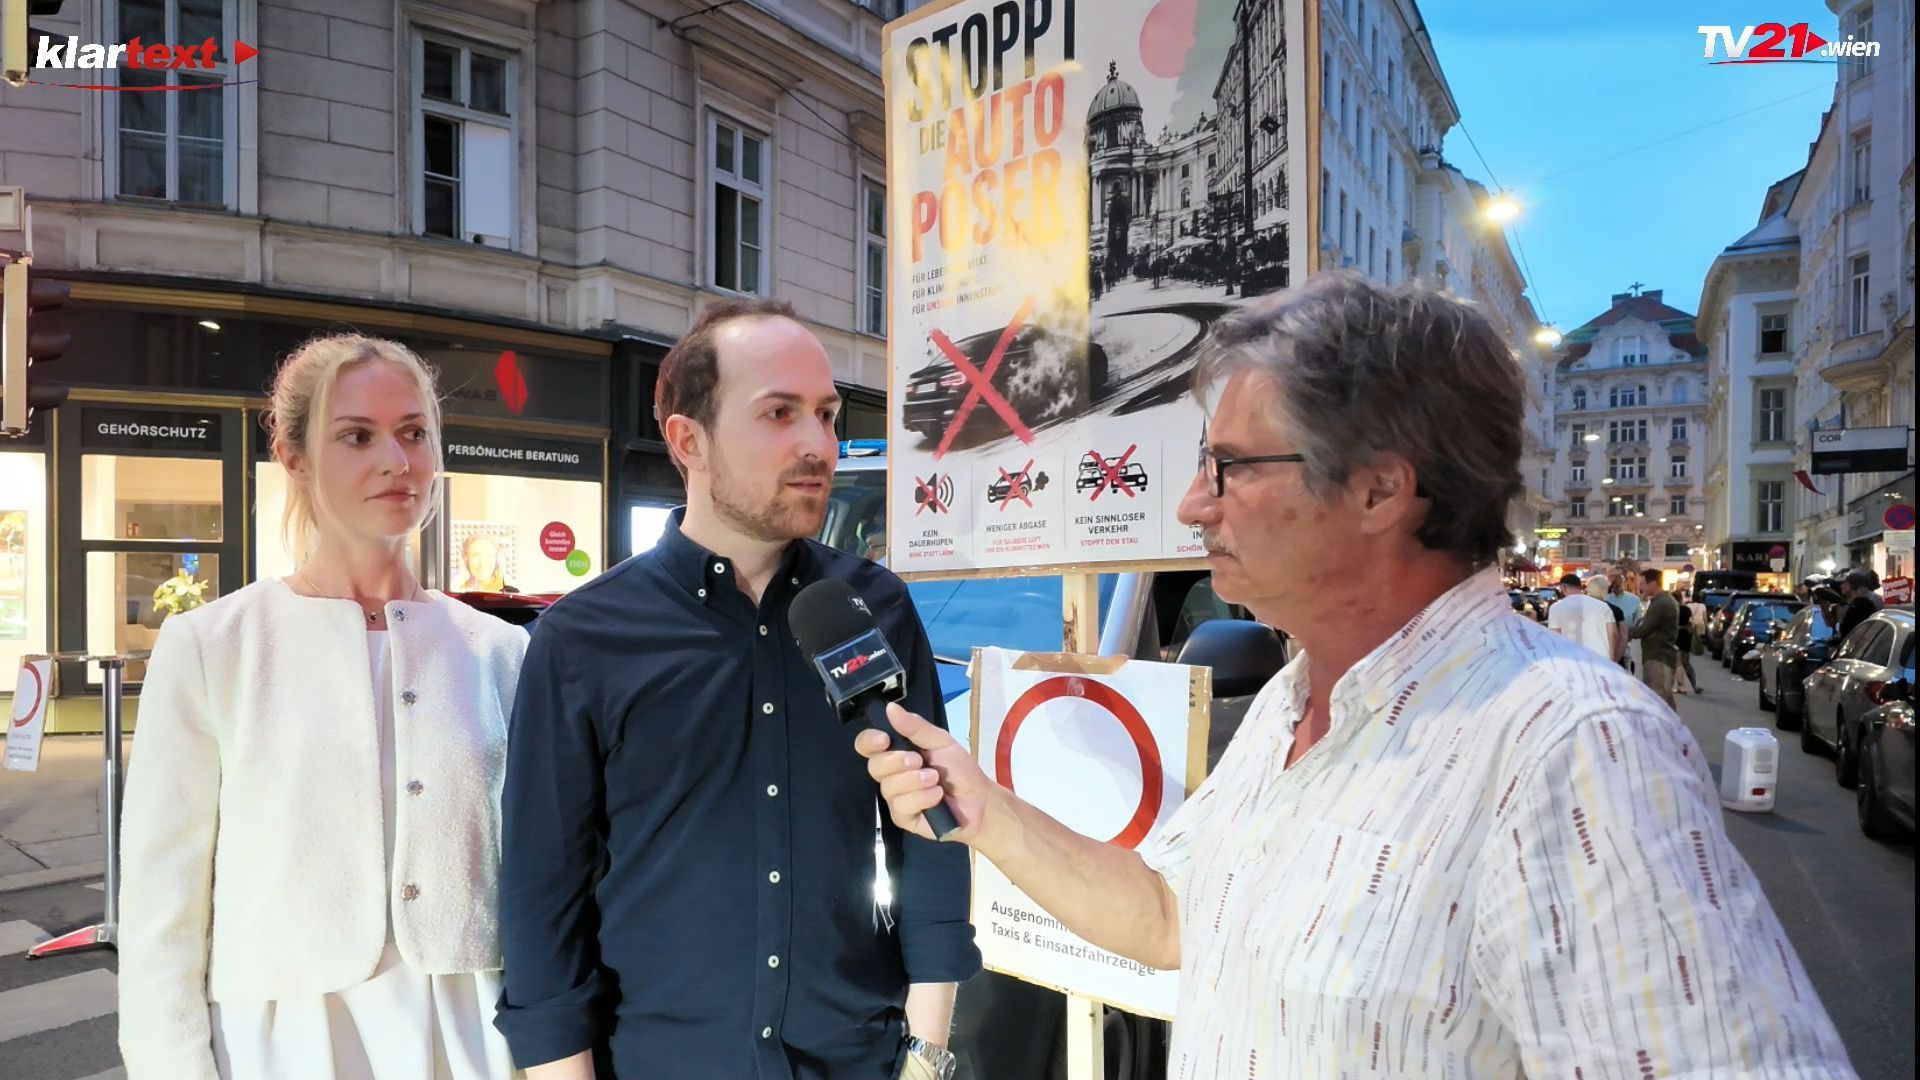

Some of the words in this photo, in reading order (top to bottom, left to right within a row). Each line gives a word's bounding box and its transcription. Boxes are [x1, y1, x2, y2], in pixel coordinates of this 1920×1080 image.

[919, 120, 945, 155] DIE
[944, 72, 1064, 181] AUTO
[912, 148, 1064, 263] POSER
[912, 272, 926, 284] FÜR
[912, 288, 926, 300] FÜR
[912, 304, 926, 315] FÜR
[97, 423, 207, 439] GEHÖRSCHUTZ
[448, 444, 523, 460] PERSÖNLICHE
[526, 451, 580, 464] BERATUNG
[1075, 516, 1093, 525] KEIN
[1096, 512, 1146, 524] SINNLOSER
[986, 523, 1017, 532] WENIGER
[1019, 520, 1047, 530] ABGASE
[1089, 525, 1129, 534] VERKEHR
[923, 529, 938, 537] KEIN
[909, 538, 953, 548] DAUERHUPEN
[1121, 537, 1139, 545] STAU
[991, 921, 1020, 941] Taxis
[1023, 931, 1032, 944] &
